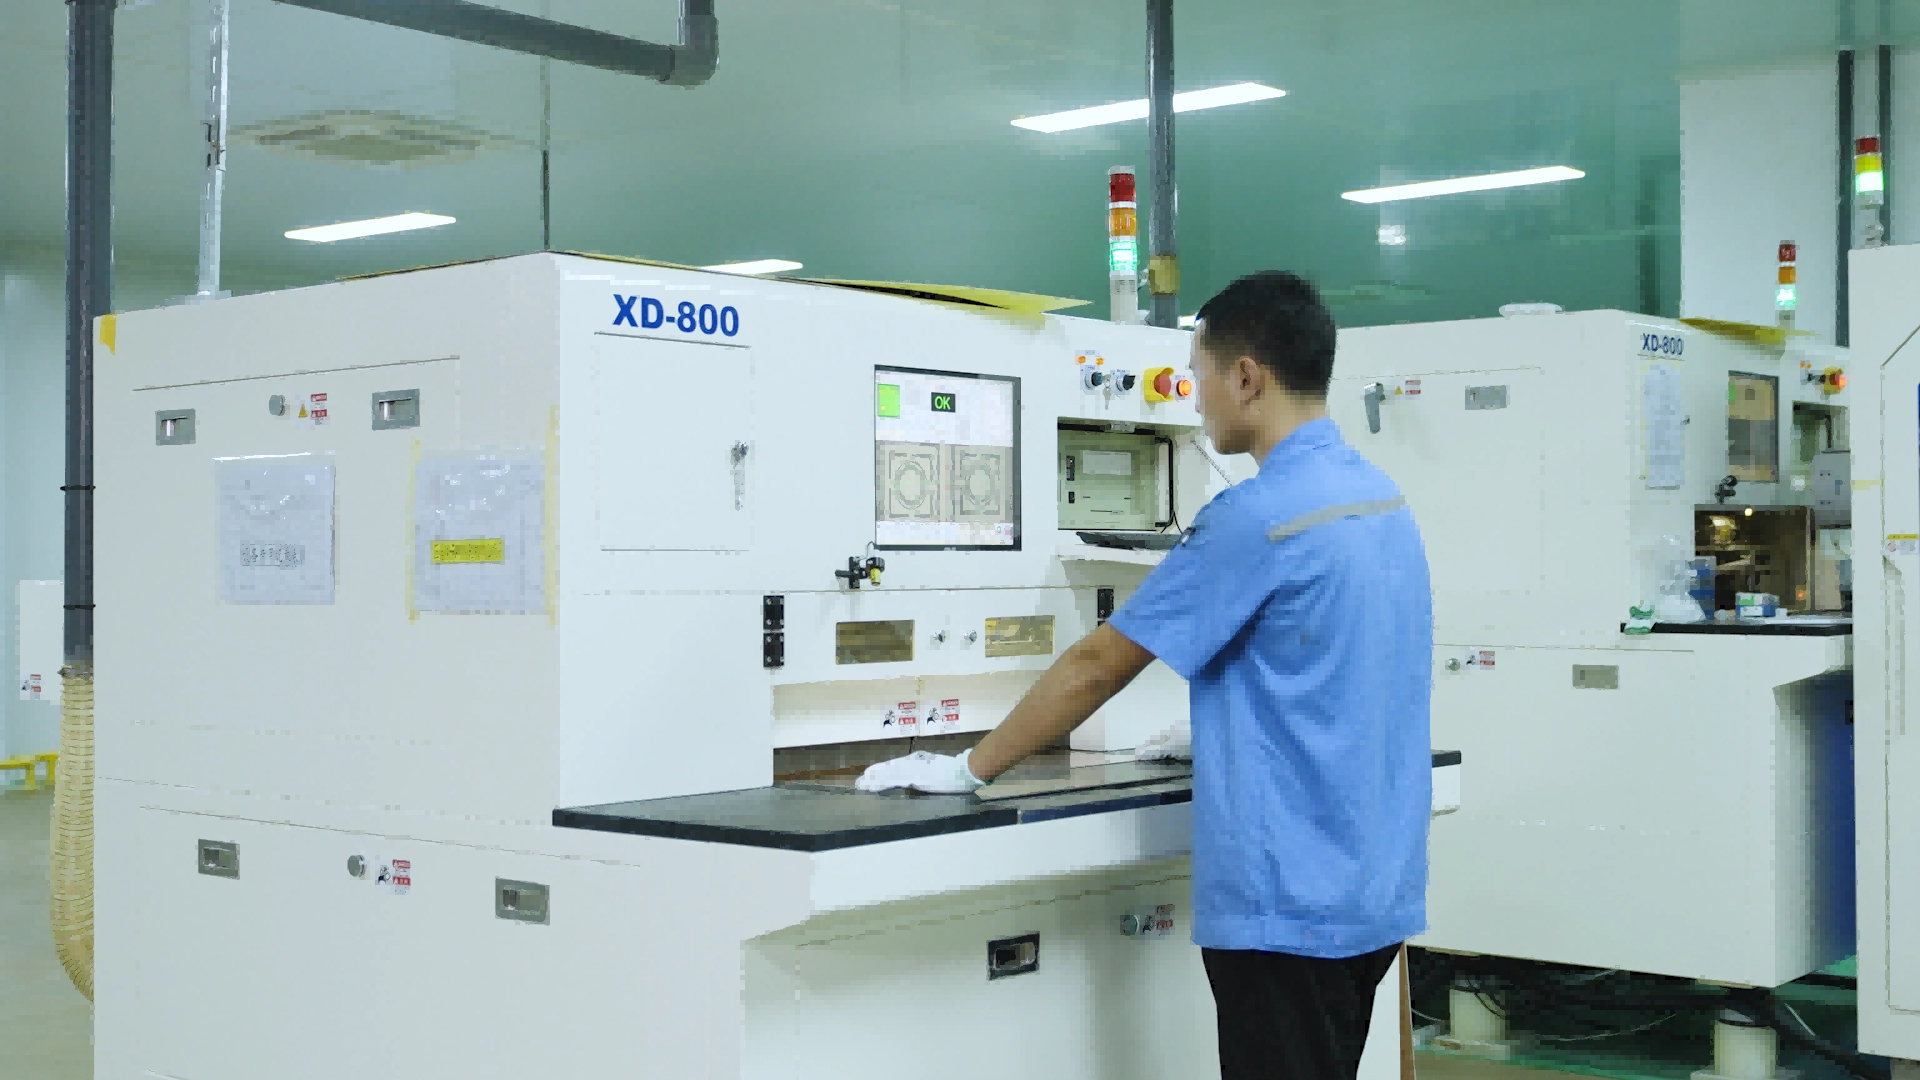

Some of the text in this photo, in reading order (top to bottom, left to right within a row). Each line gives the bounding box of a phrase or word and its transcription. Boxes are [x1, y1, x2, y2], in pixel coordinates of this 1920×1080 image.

[612, 293, 740, 337] XD-800
[1642, 332, 1683, 356] XD-800
[934, 395, 951, 410] OK
